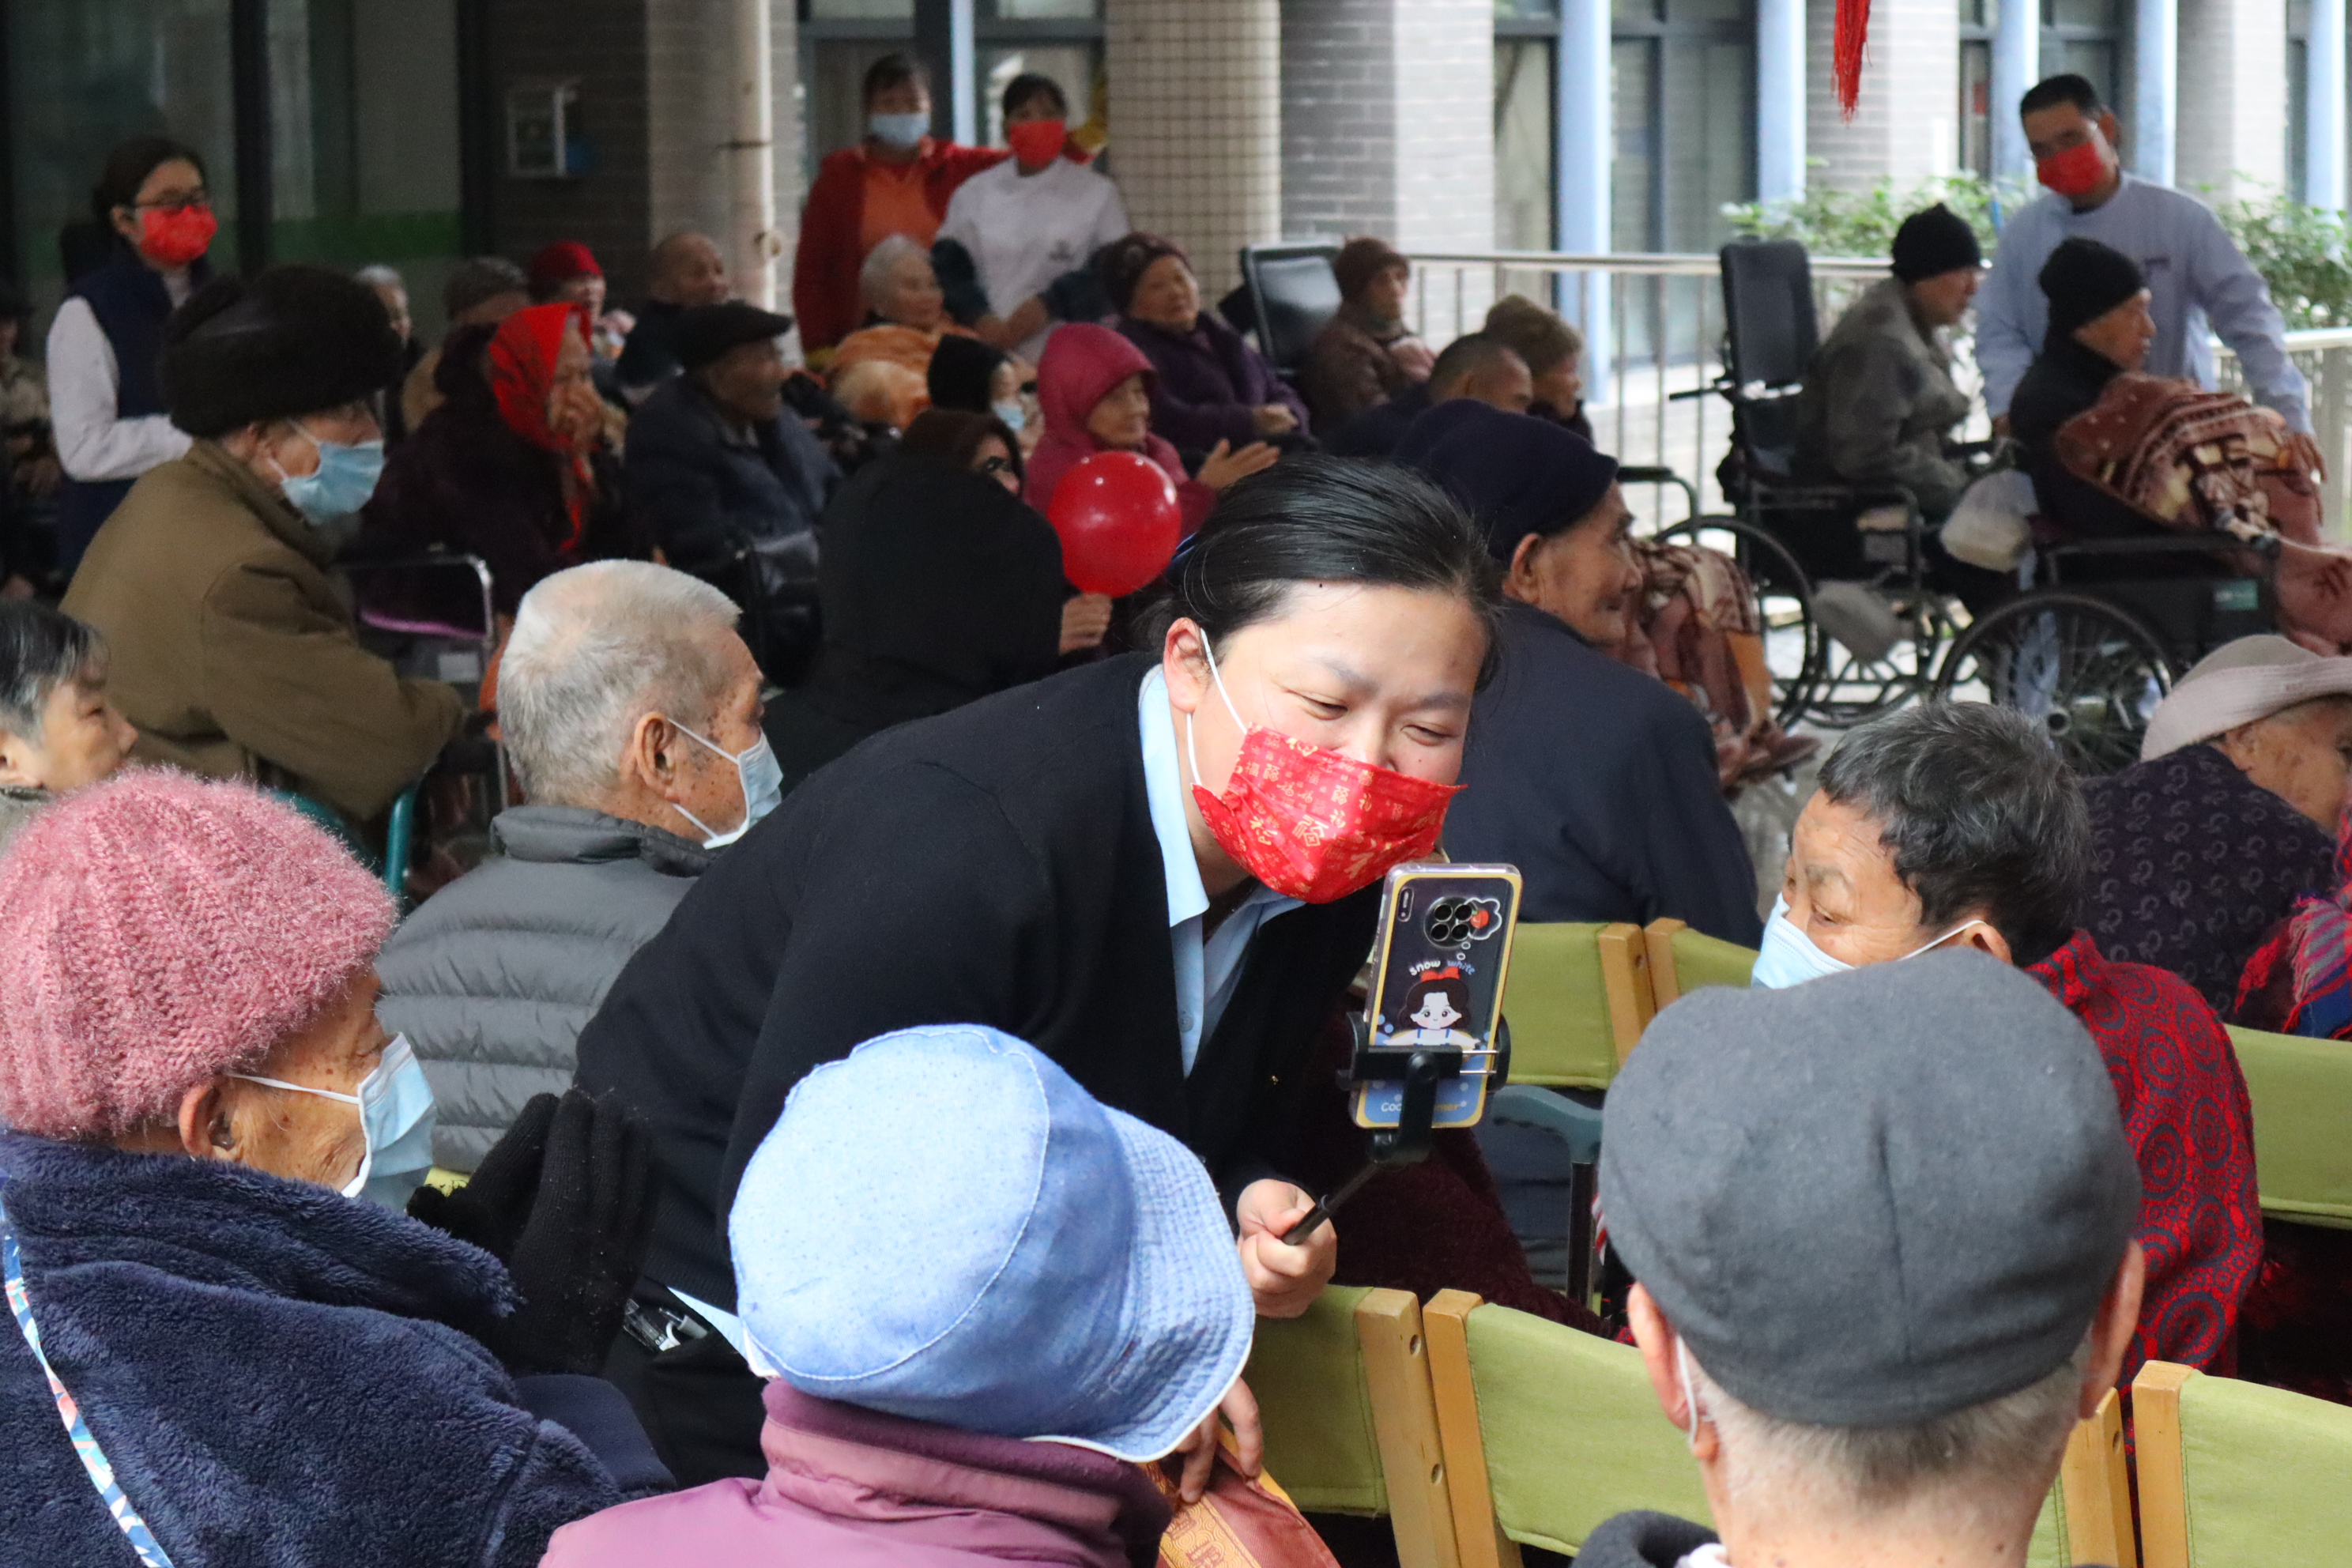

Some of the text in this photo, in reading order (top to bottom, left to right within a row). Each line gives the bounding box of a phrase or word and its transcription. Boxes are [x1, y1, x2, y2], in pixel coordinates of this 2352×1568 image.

[1246, 761, 1260, 777] 福
[1292, 814, 1329, 846] 福
[1409, 959, 1476, 976] snow white
[1381, 1102, 1402, 1113] Coo
